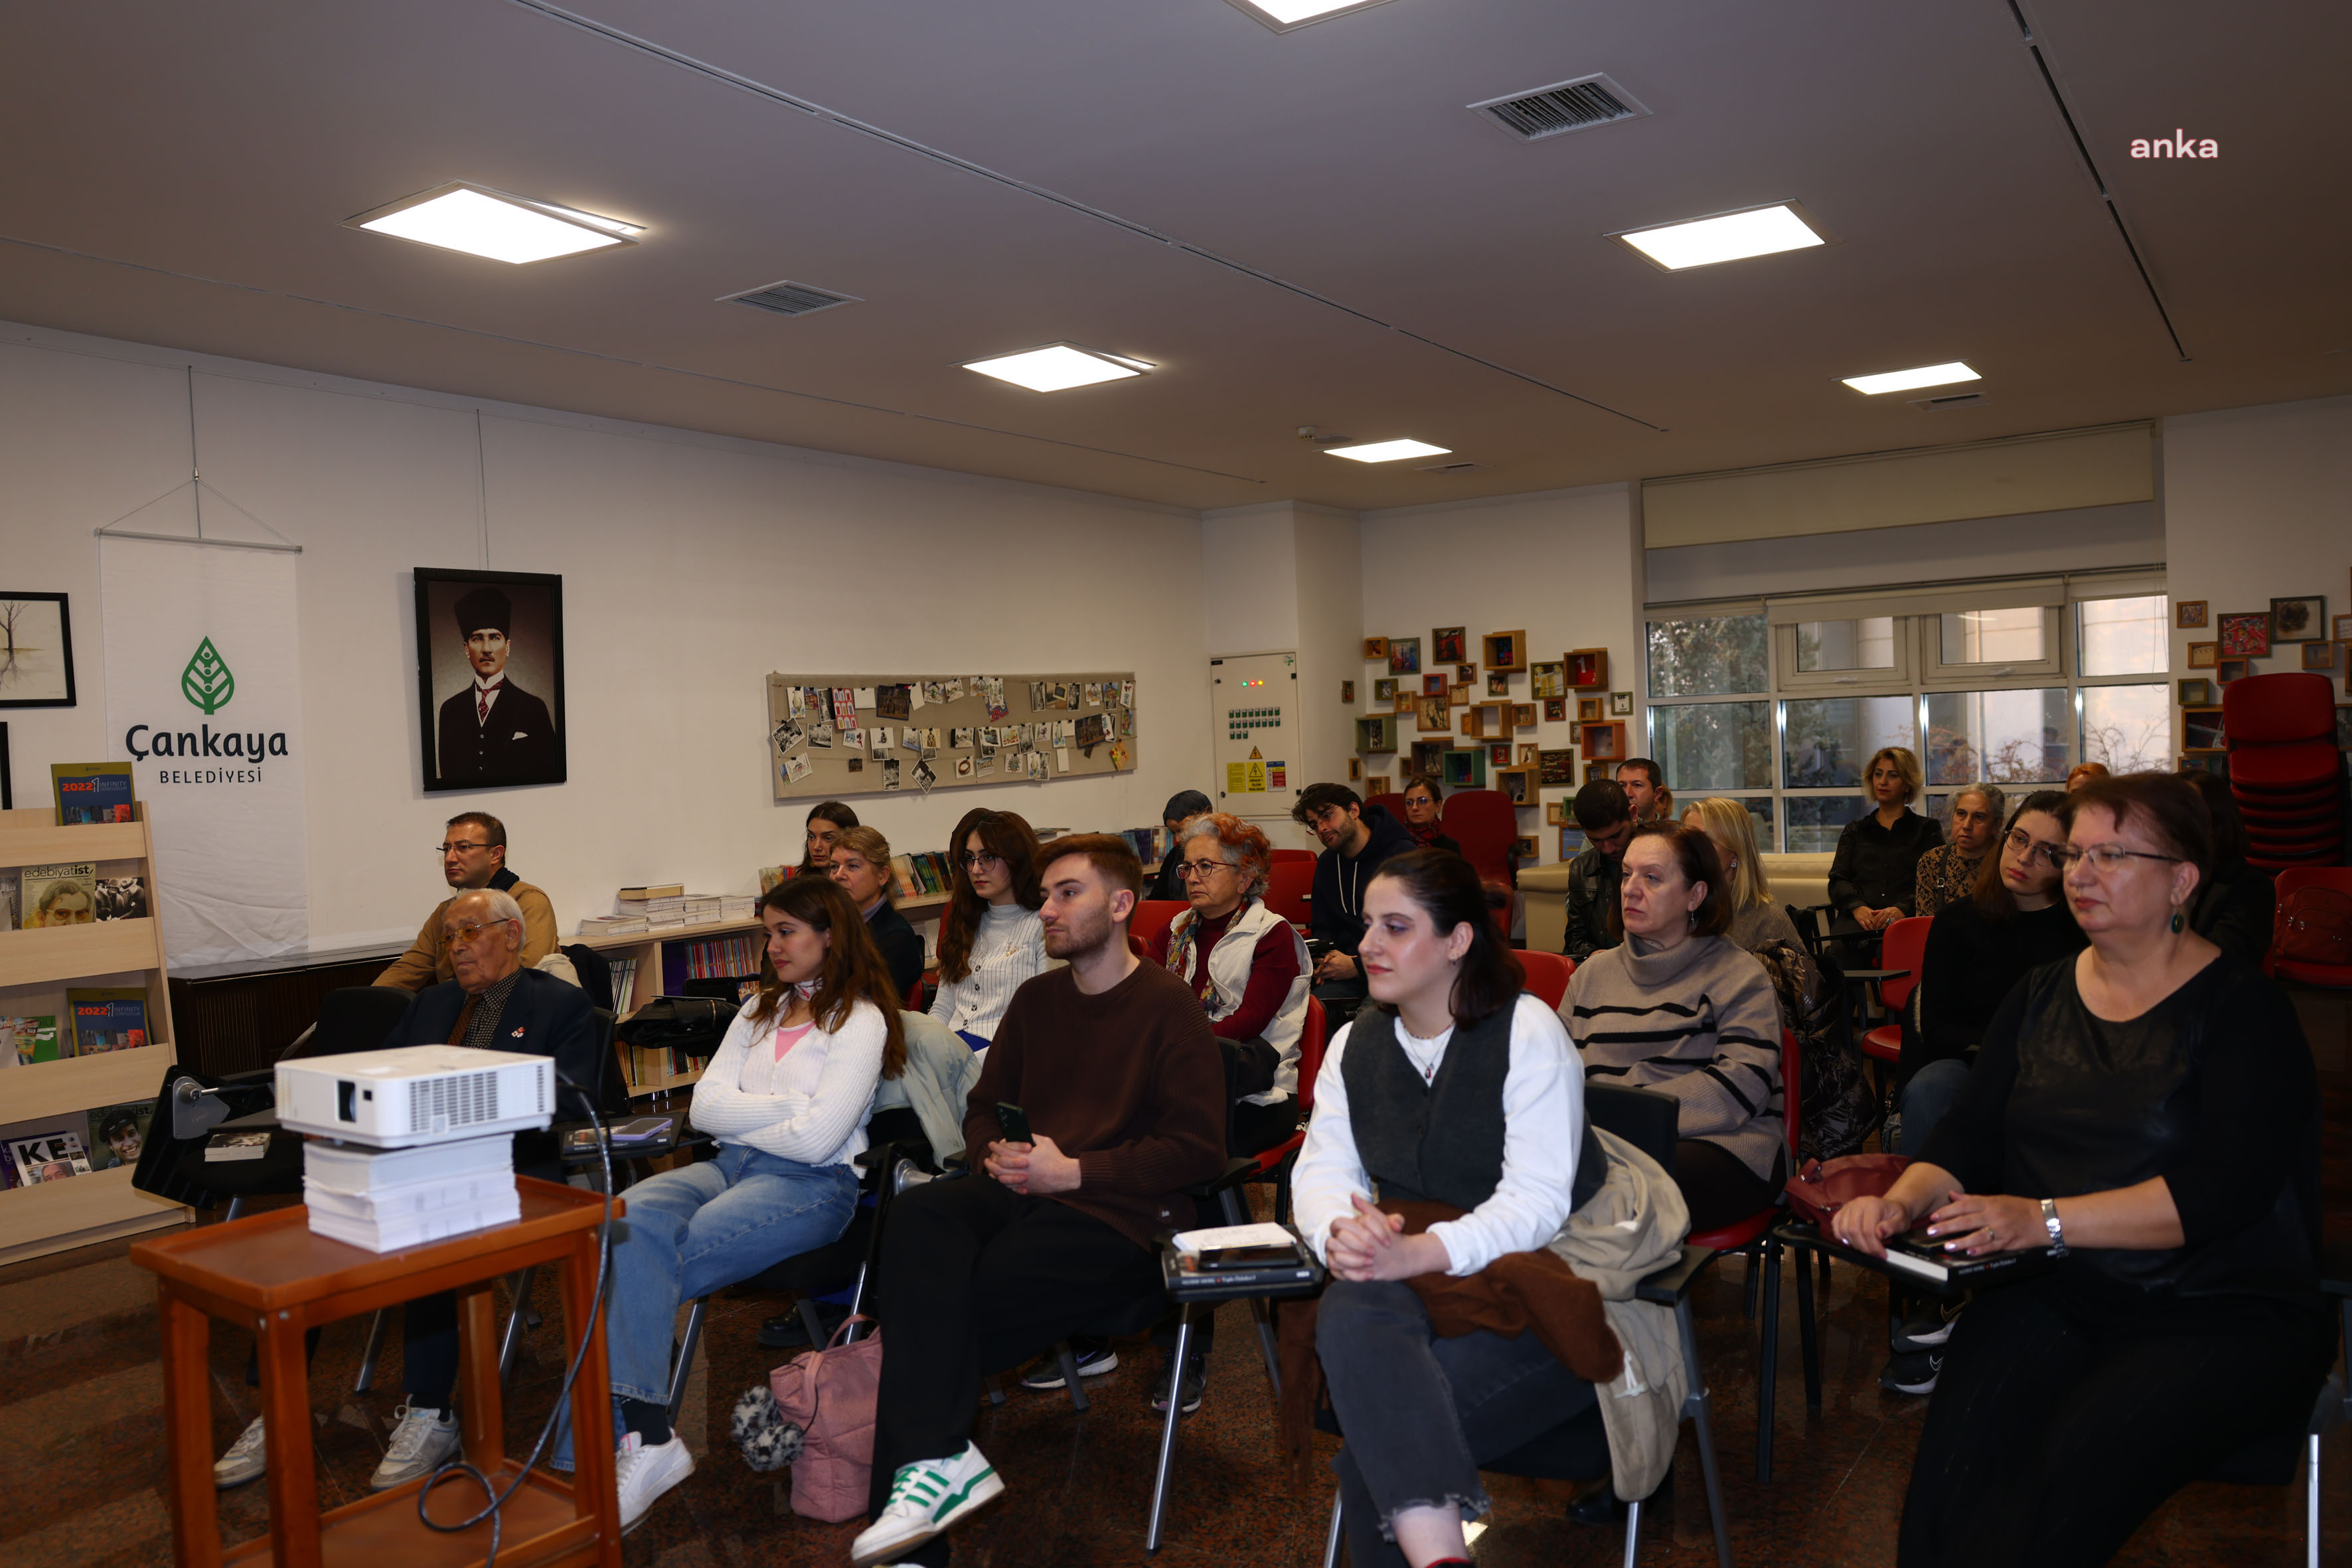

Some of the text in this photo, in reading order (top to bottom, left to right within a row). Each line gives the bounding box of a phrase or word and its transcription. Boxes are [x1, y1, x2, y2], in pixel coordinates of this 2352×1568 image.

[125, 724, 288, 763] Çankaya
[160, 767, 262, 783] BELEDİYESİ
[62, 782, 94, 792] 2022
[77, 1006, 108, 1016] 2022
